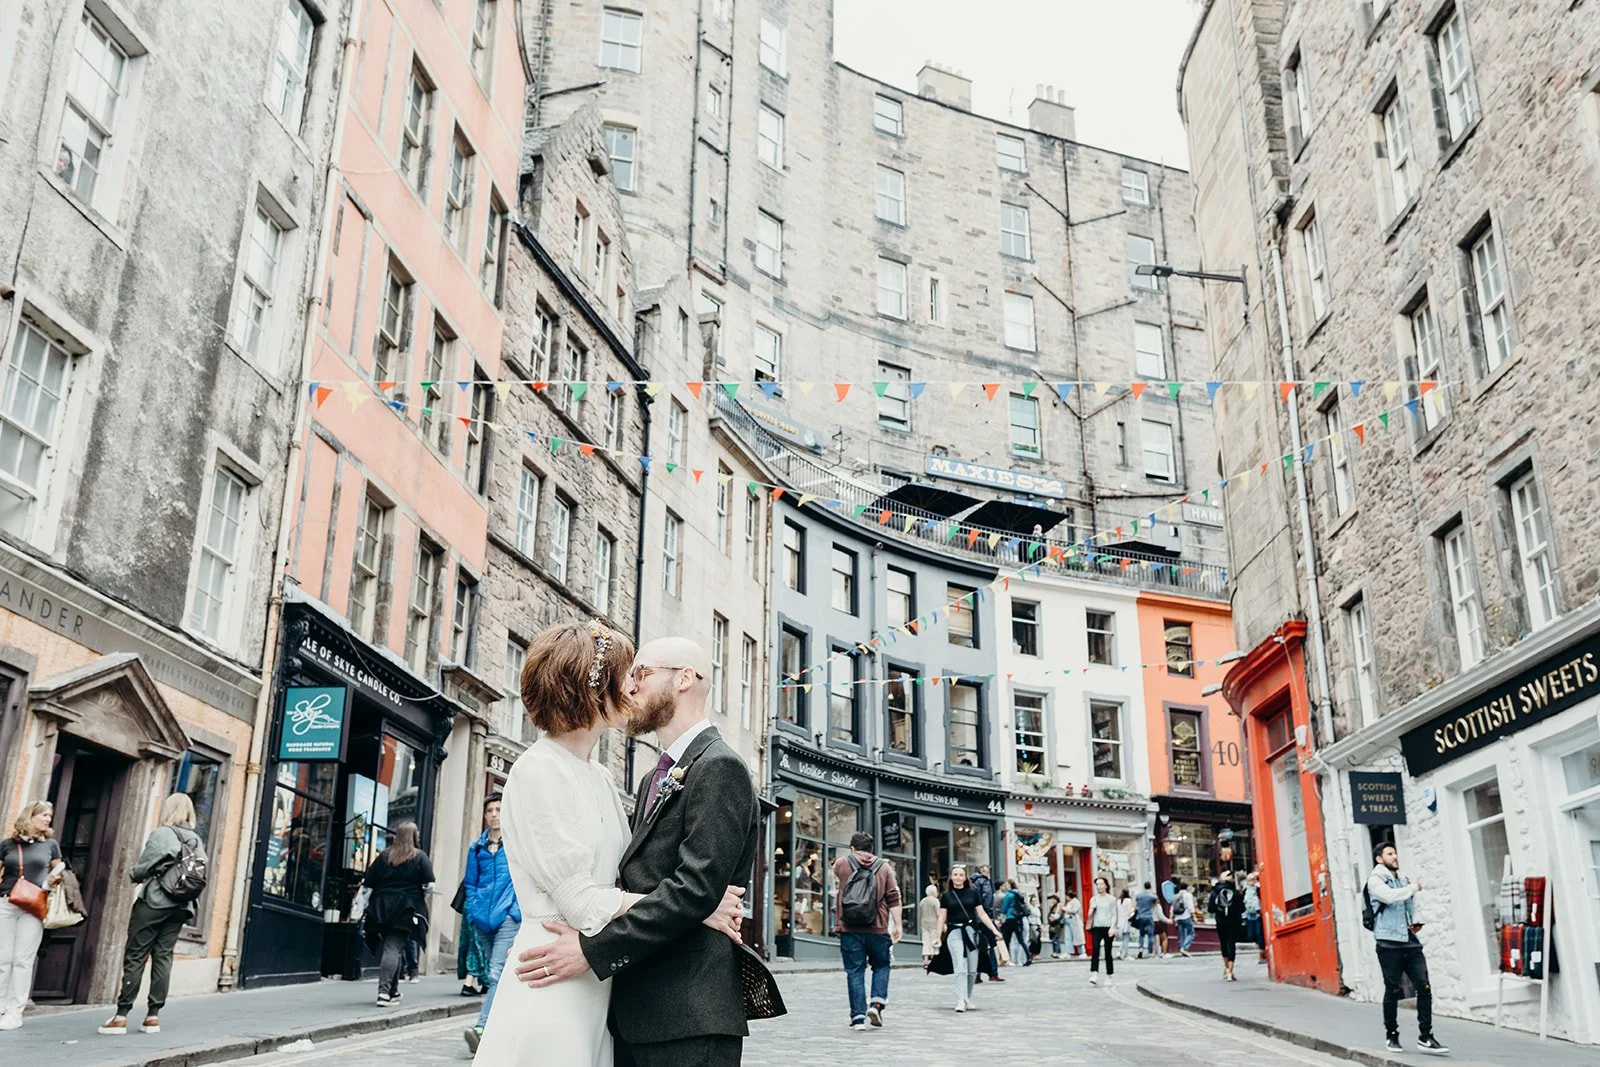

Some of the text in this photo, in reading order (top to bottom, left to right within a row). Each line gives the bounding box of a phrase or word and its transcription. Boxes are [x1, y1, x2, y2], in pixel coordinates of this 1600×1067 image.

[320, 646, 332, 661] OF
[334, 655, 355, 677] SKYE
[357, 670, 387, 697] CANDLE
[1434, 652, 1598, 754] SCOTTISH SWEETS
[1212, 741, 1239, 767] 40
[491, 755, 505, 772] 89
[799, 762, 858, 788] Walker Slater
[1357, 783, 1397, 791] SCOTTISH
[914, 791, 959, 807] LADIESWEAR
[1362, 794, 1394, 802] SWEETS
[1360, 804, 1398, 813] & TREATS
